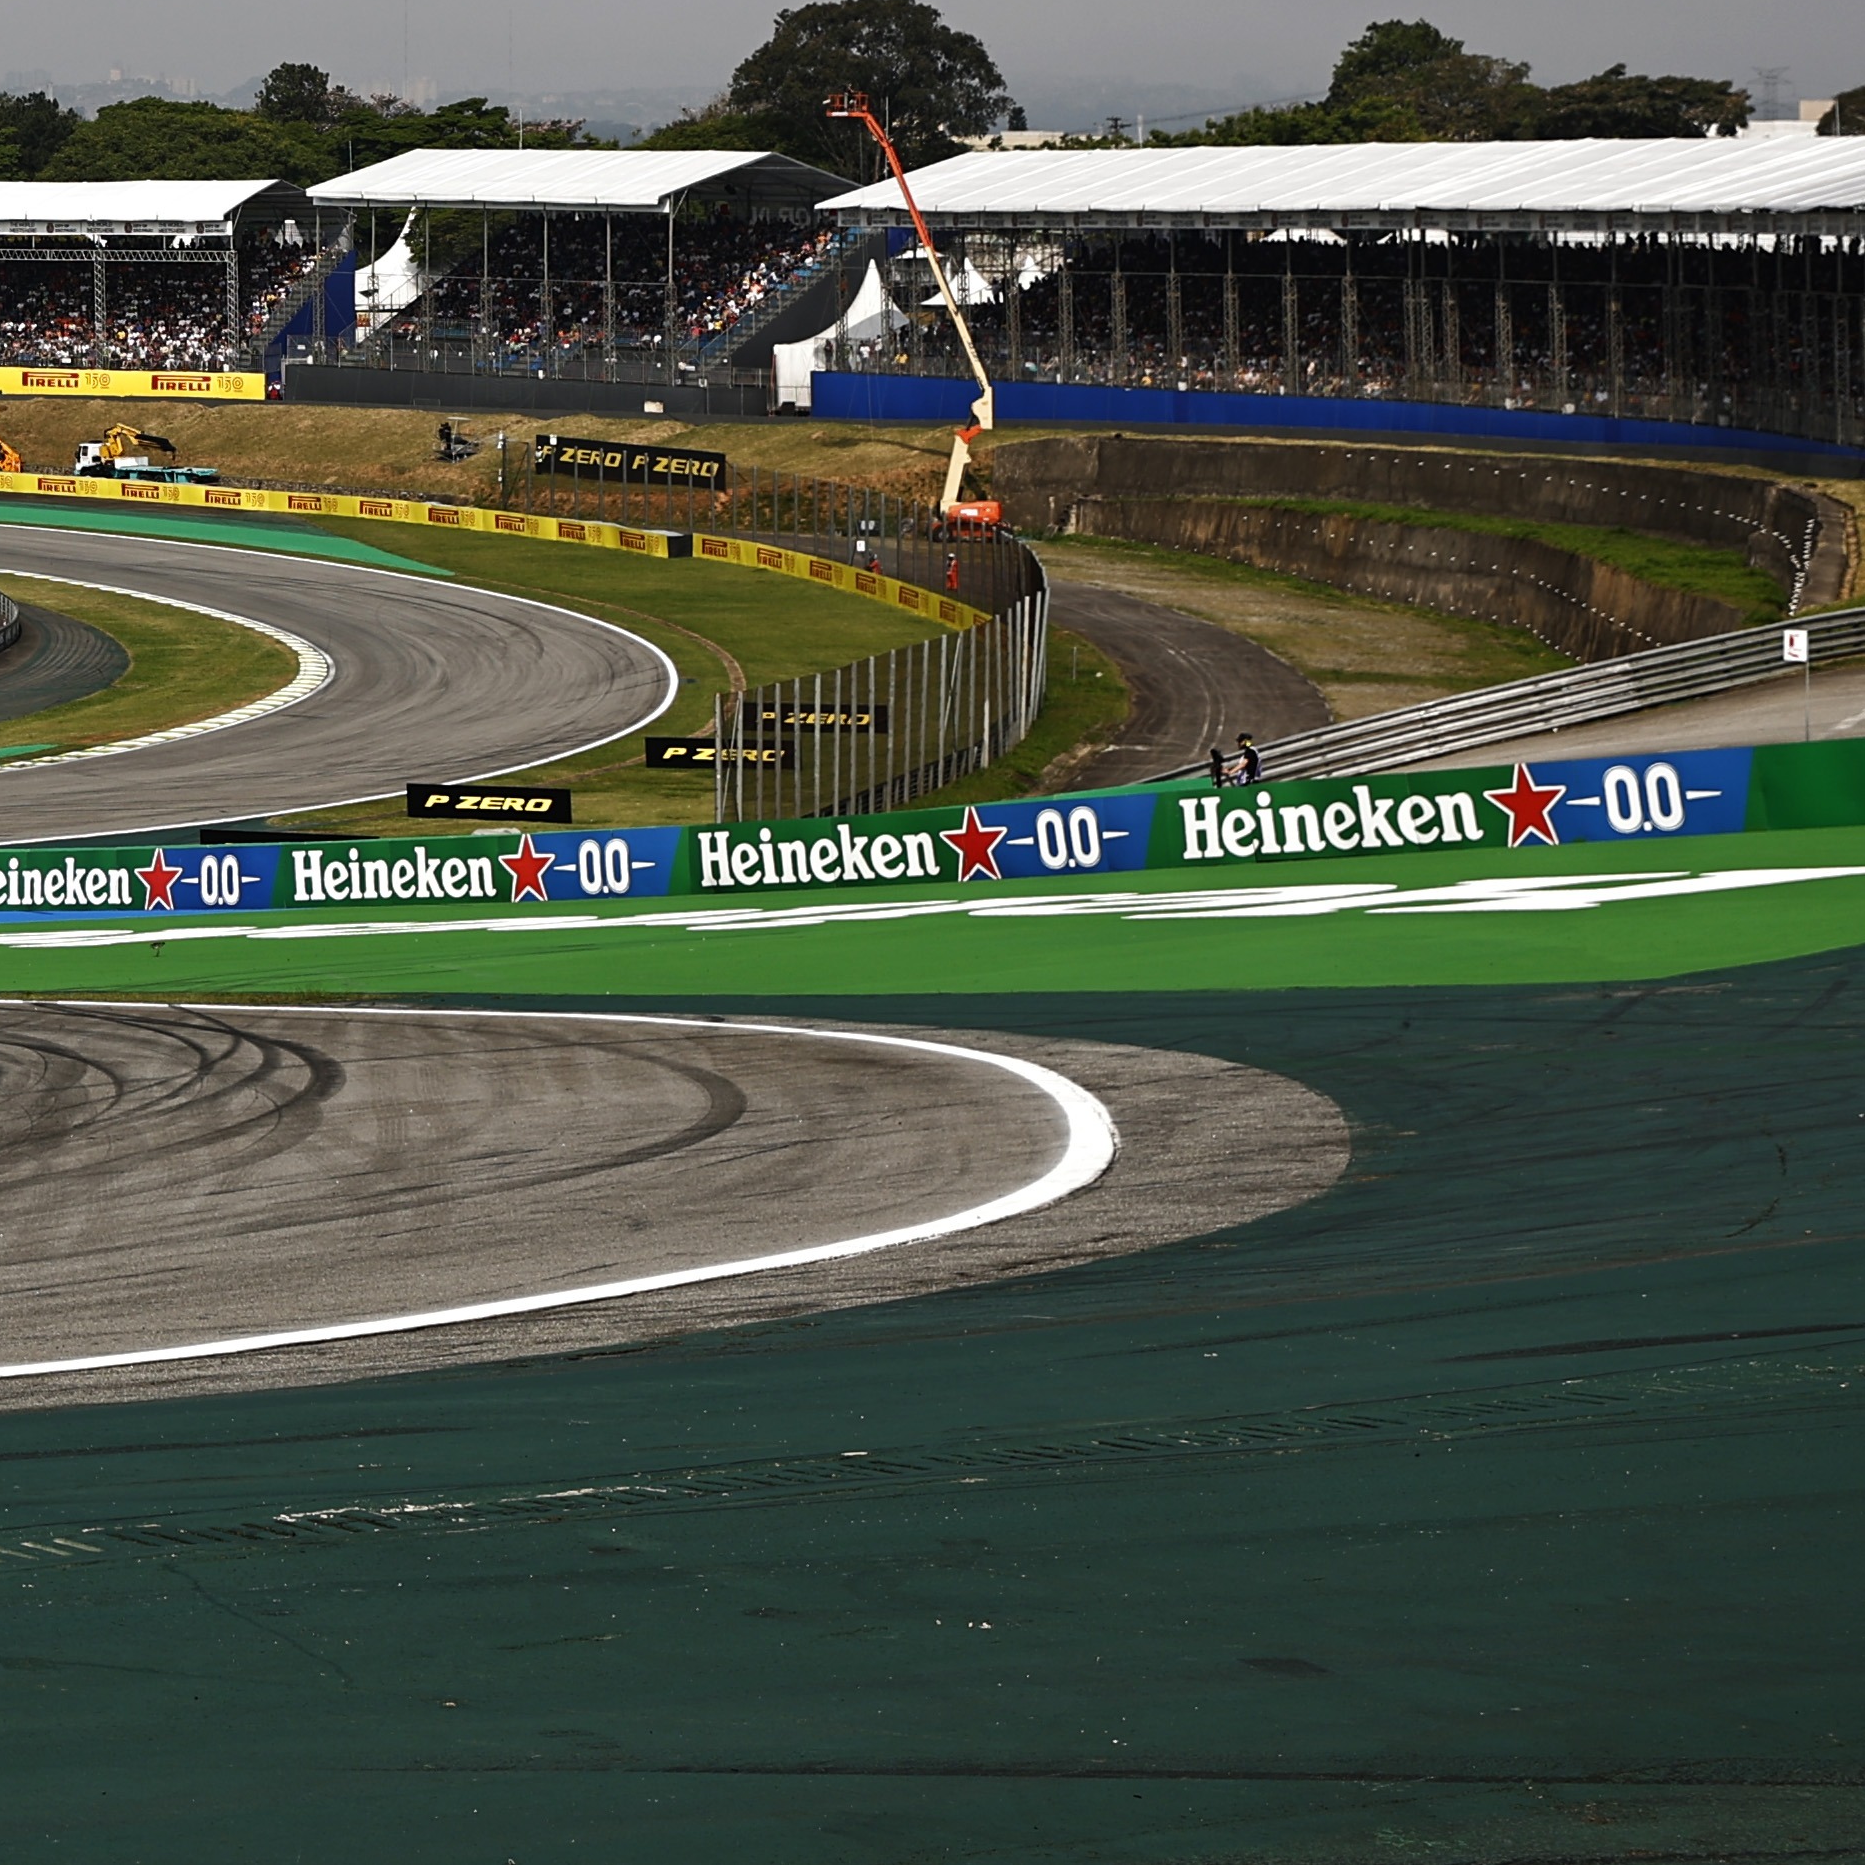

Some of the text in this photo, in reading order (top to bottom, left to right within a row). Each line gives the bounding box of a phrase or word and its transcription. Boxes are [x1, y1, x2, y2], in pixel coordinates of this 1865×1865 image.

[22, 371, 79, 388] PIRELLI
[151, 374, 211, 391] PIRELLI
[559, 447, 622, 467] ZERO
[652, 456, 719, 478] ZERO
[38, 478, 76, 493] PIRELLI
[121, 483, 159, 499] PIRELLI
[205, 489, 242, 505] PIRELLI
[288, 495, 321, 511] PIRELLI
[359, 500, 392, 517] PIRELLI
[495, 514, 525, 532] PIRELLI
[663, 747, 688, 760] P
[424, 794, 553, 812] P ZERO
[1179, 762, 1687, 860] Heineken 0.0
[697, 806, 1103, 888] Heineken 0.0
[291, 838, 630, 902] Heineken 0.0
[199, 854, 241, 907] 0.0
